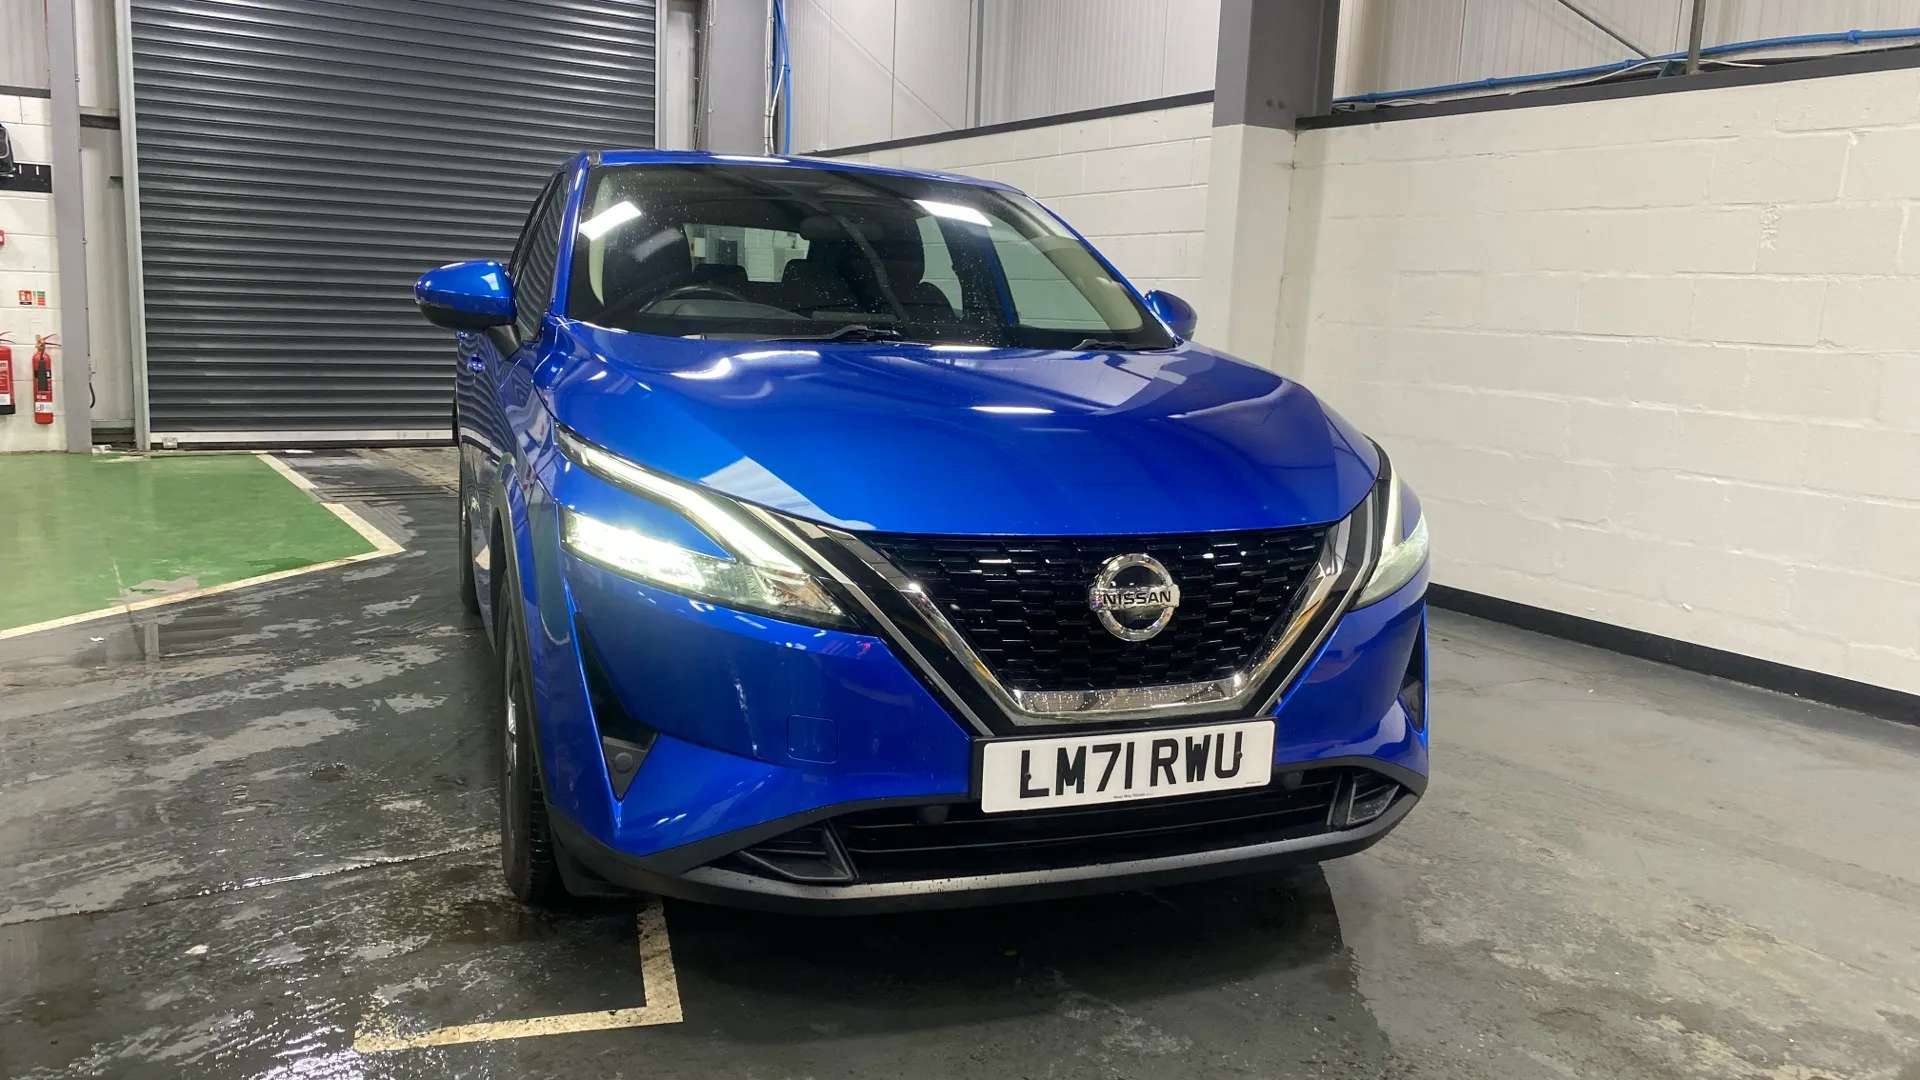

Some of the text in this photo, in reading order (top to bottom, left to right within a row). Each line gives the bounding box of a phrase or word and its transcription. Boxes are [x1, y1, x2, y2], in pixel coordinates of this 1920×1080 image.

[1103, 591, 1171, 605] NISSAN
[1019, 731, 1243, 799] LM71 RWU
